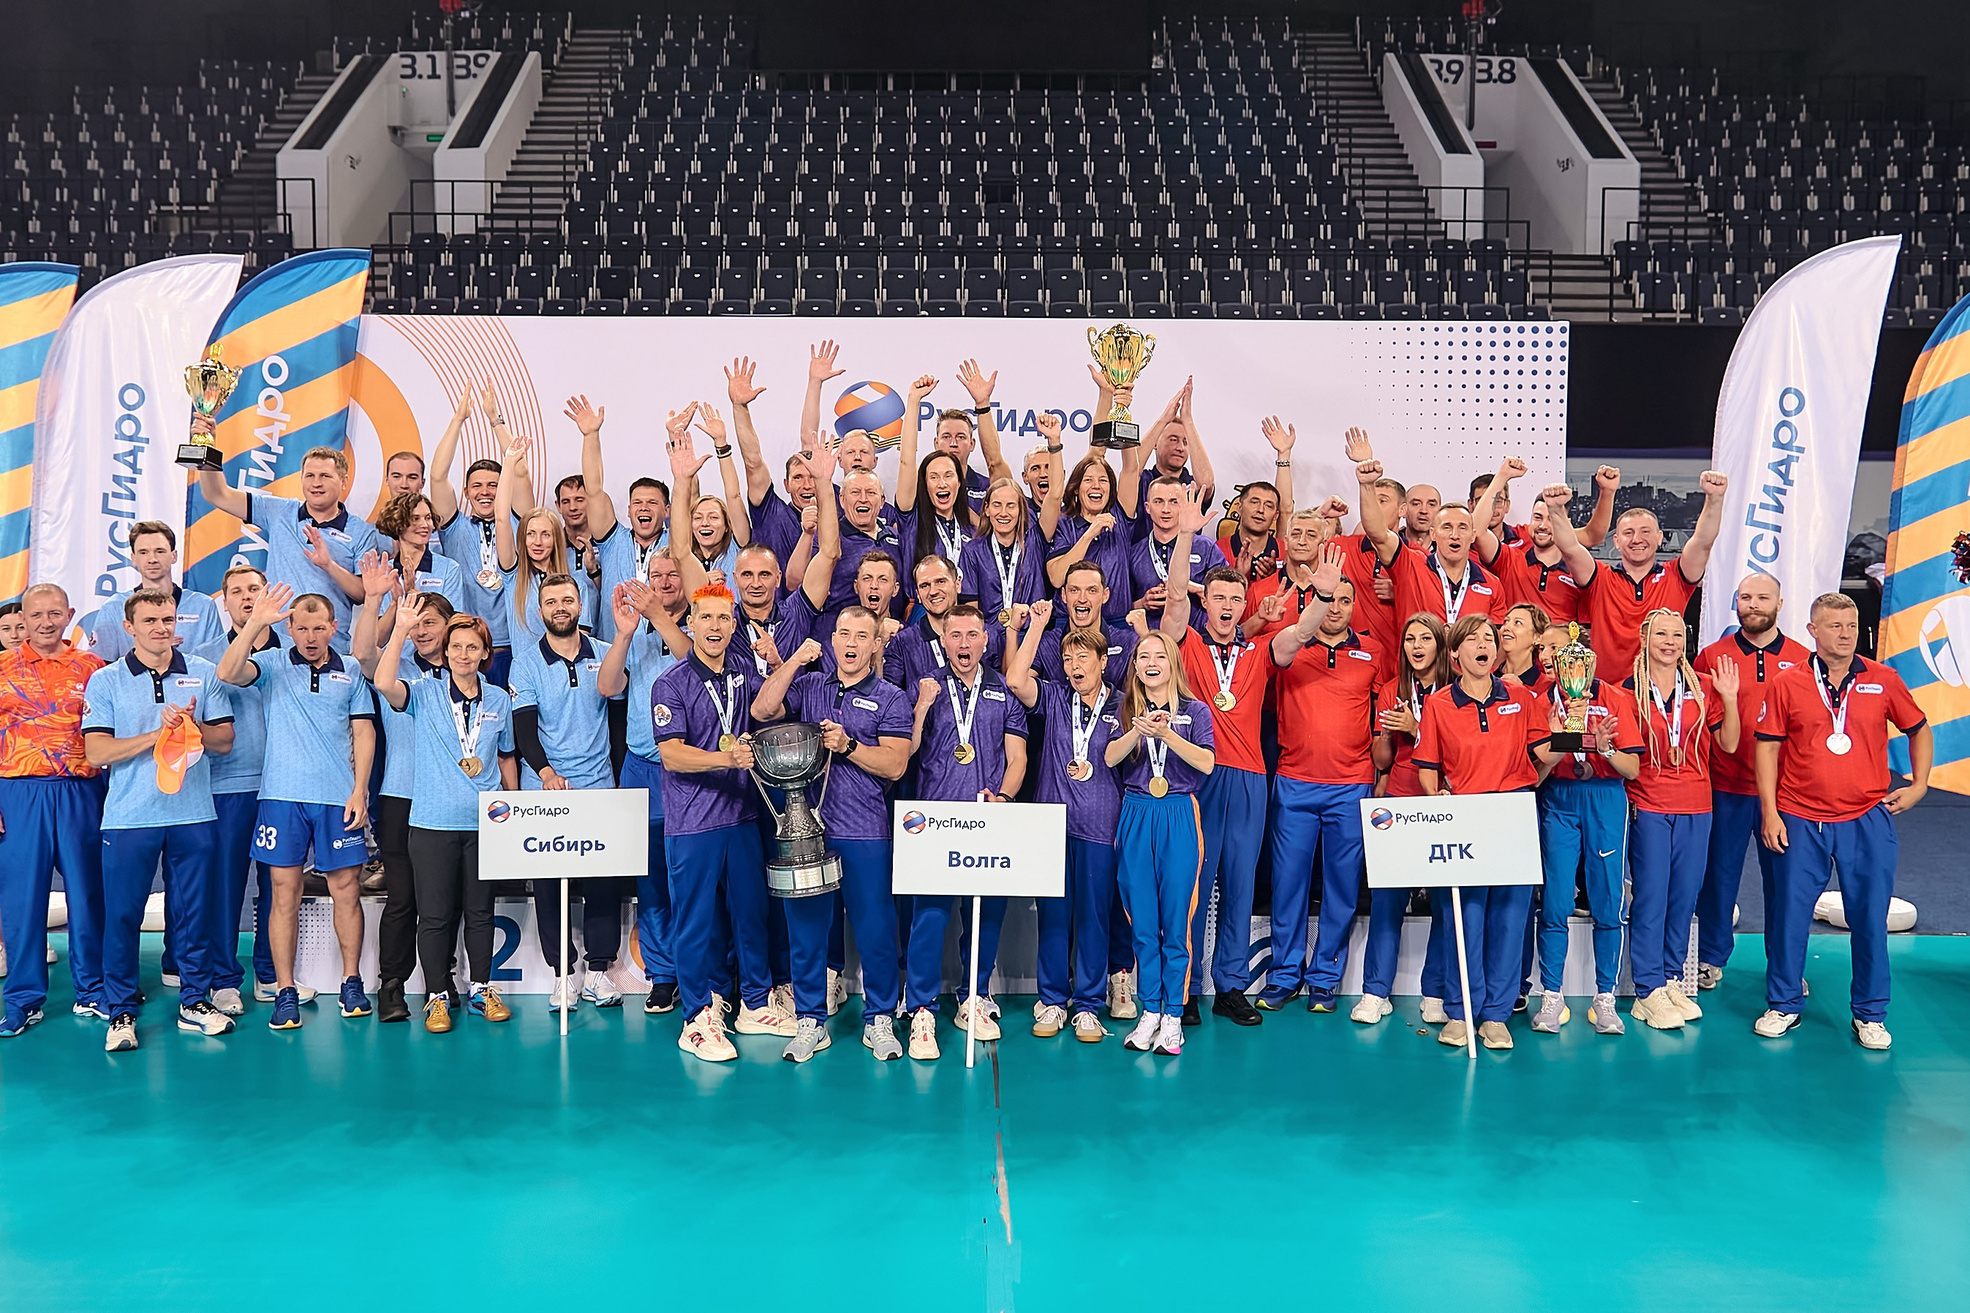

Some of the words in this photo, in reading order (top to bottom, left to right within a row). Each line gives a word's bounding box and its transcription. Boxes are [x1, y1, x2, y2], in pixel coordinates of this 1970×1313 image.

[399, 53, 442, 80] 3.1
[1475, 57, 1517, 85] 3.8
[513, 805, 570, 818] РусГидро
[1395, 812, 1453, 825] РусГидро
[928, 817, 986, 831] РусГидро
[256, 824, 278, 850] 33
[523, 835, 606, 857] Сибирь
[948, 850, 1011, 869] Волга
[1428, 842, 1475, 863] ДГК
[490, 915, 523, 982] 2
